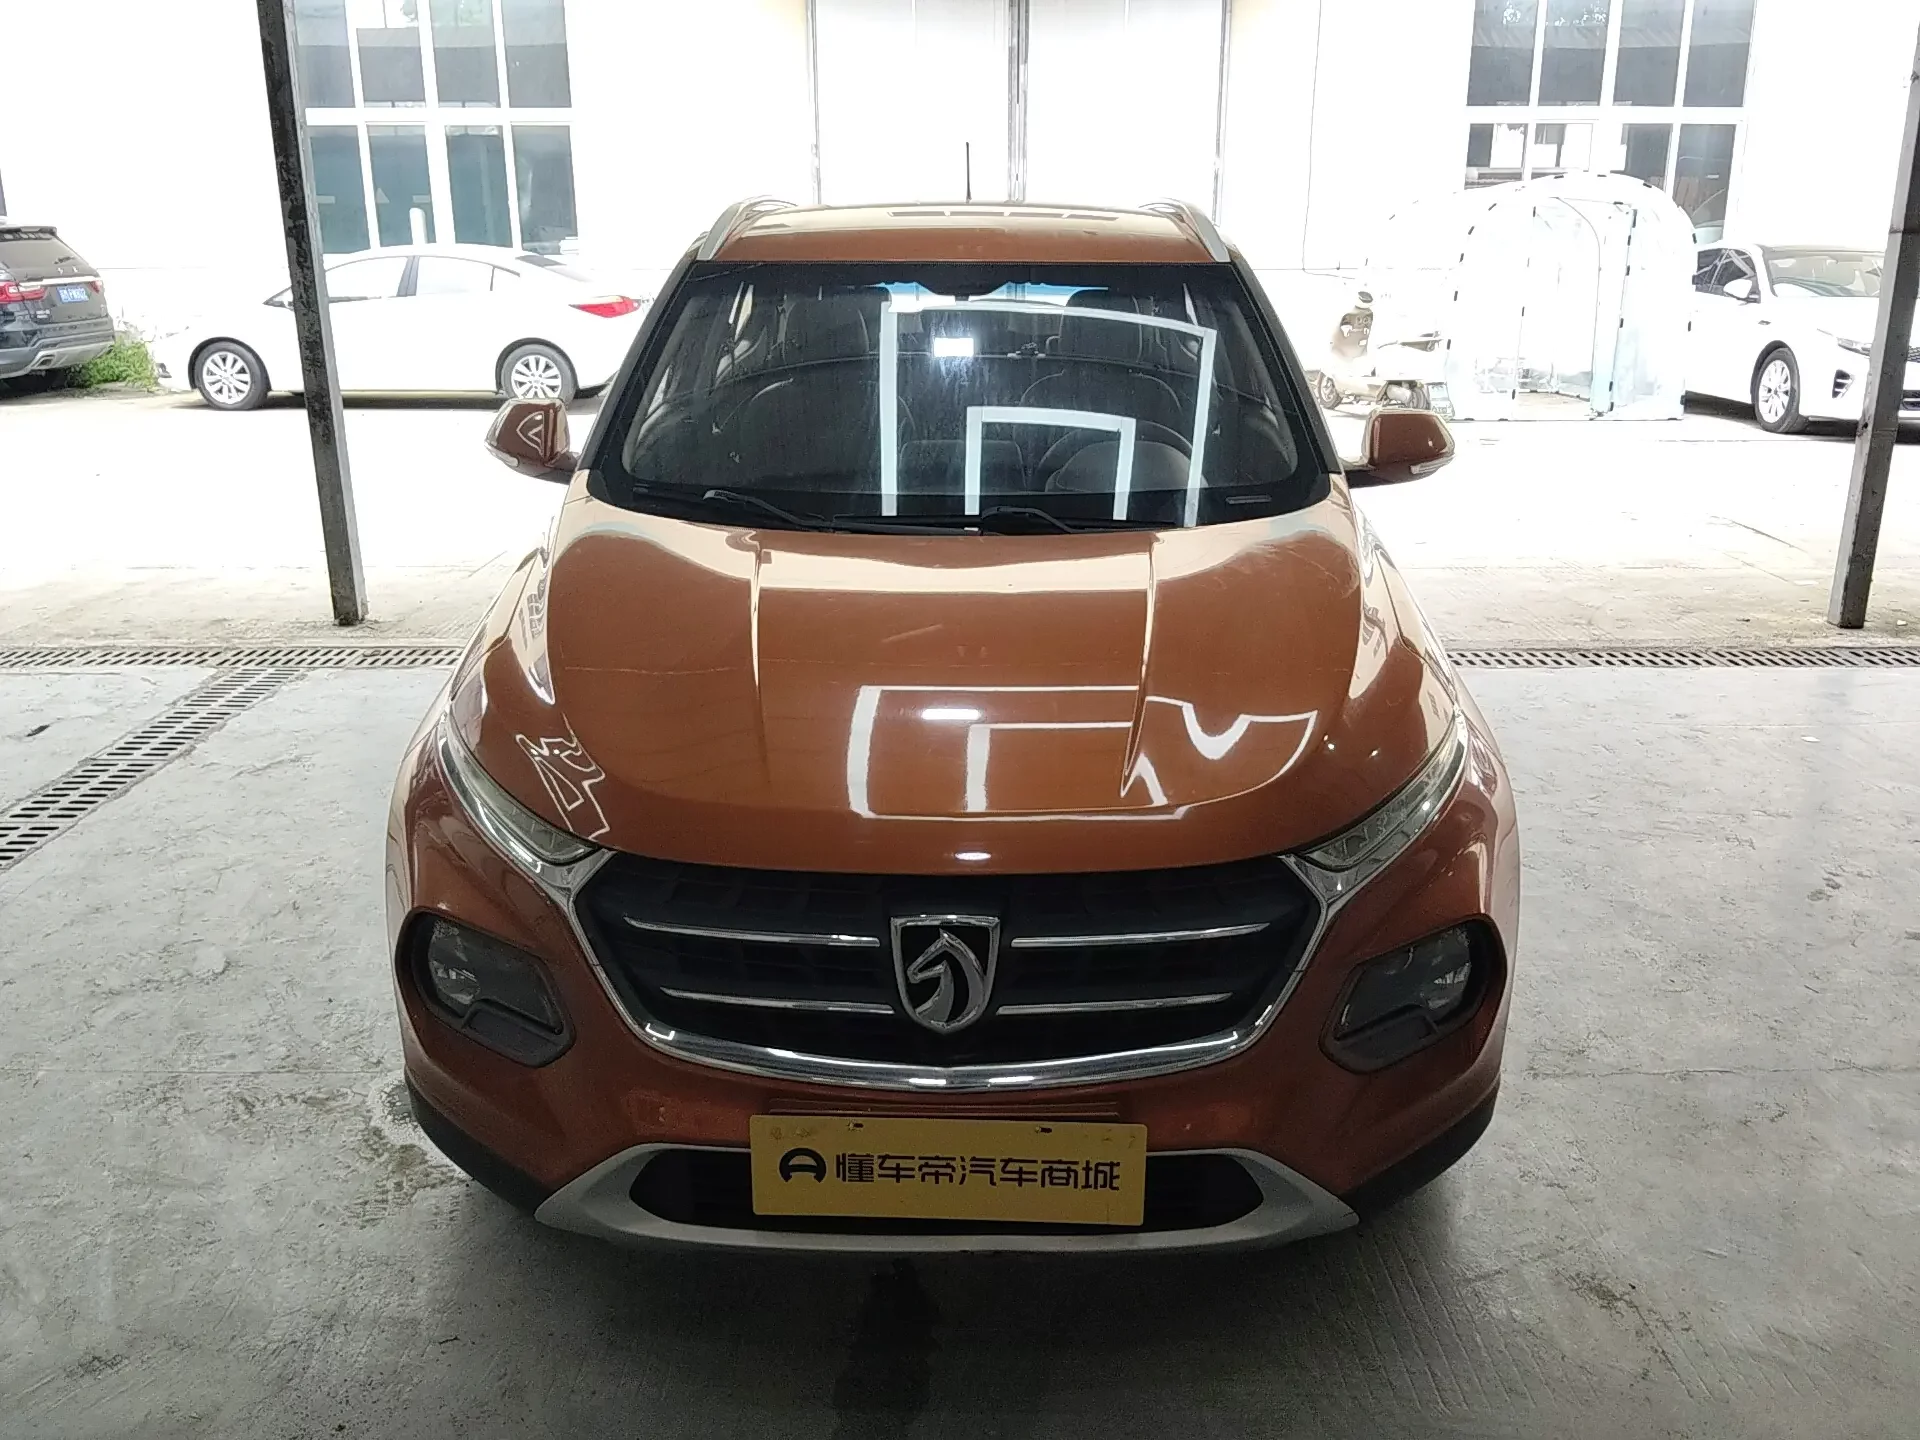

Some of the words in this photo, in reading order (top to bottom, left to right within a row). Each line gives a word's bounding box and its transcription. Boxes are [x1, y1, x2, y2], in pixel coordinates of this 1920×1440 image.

[835, 1152, 1120, 1190] 懂车帝汽车商城
